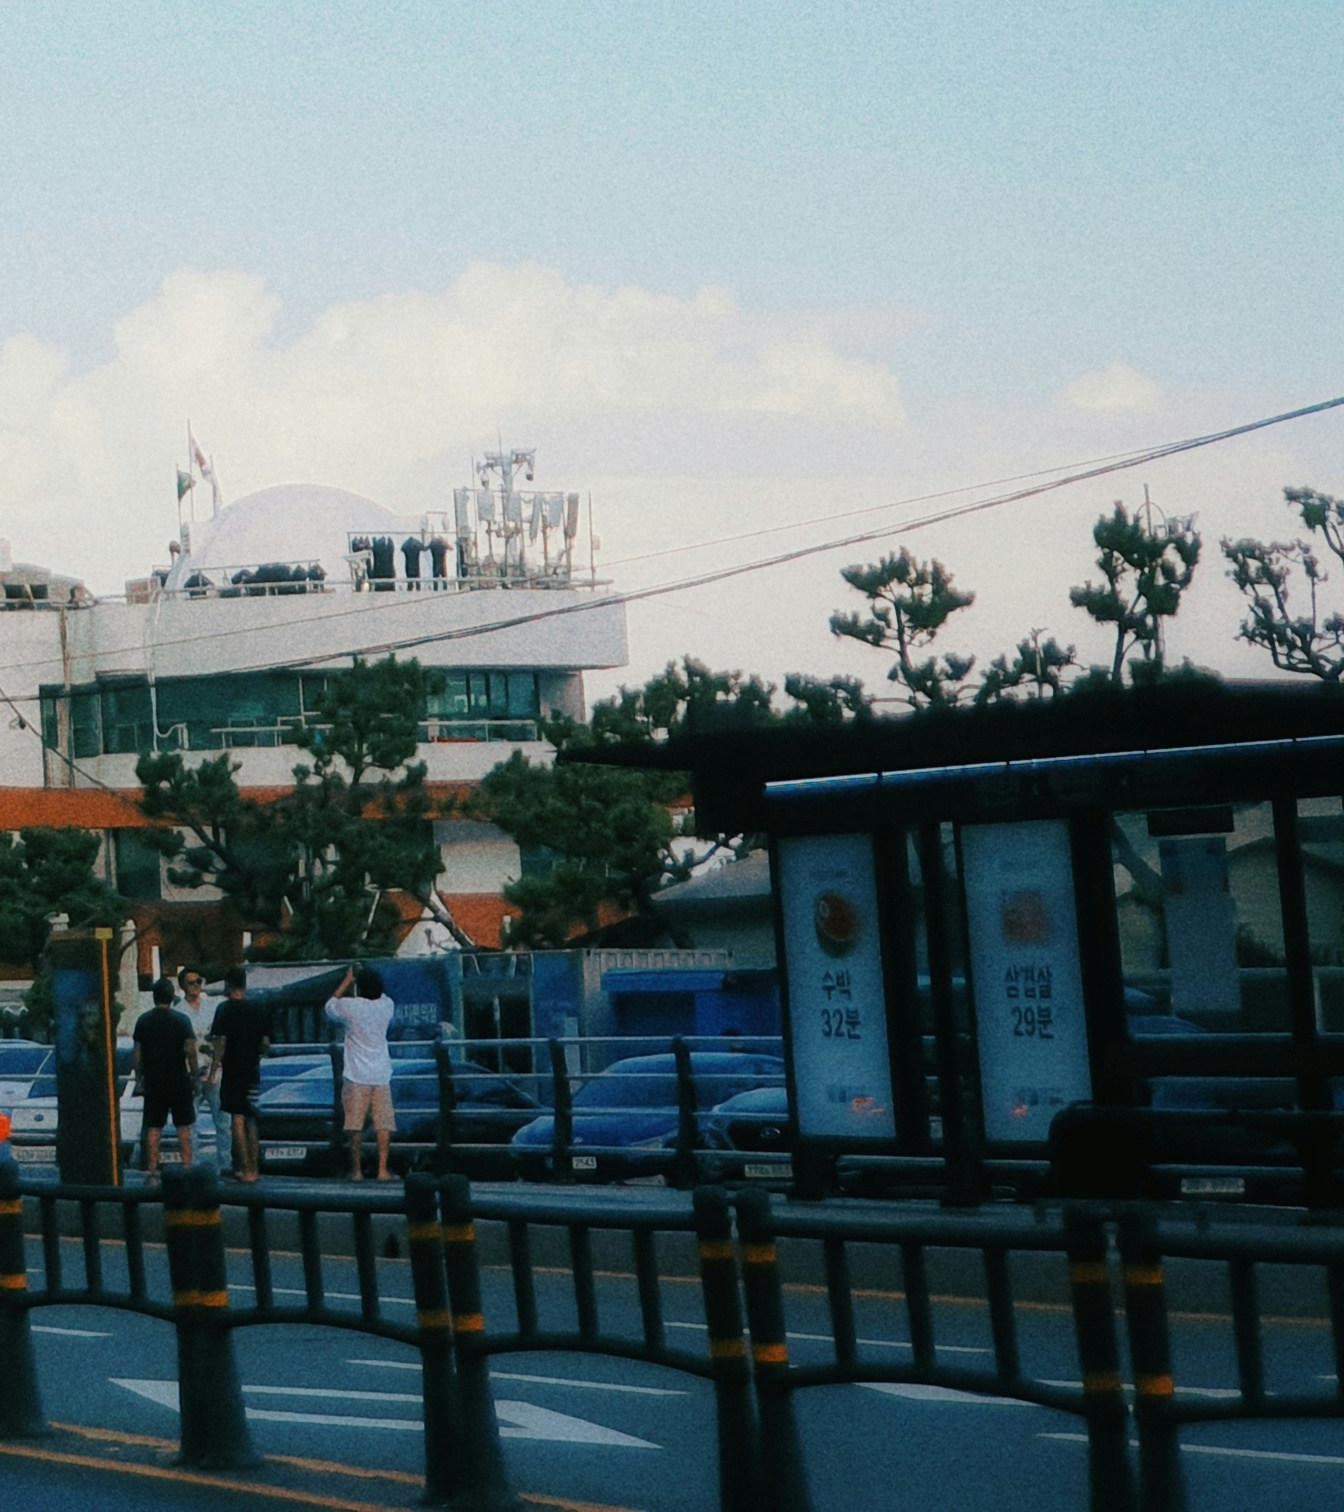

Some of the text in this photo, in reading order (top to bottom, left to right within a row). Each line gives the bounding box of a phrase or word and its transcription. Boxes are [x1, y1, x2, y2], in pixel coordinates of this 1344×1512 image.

[821, 970, 852, 1001] 수박
[820, 1007, 862, 1041] 32분
[1011, 1005, 1055, 1040] 29분
